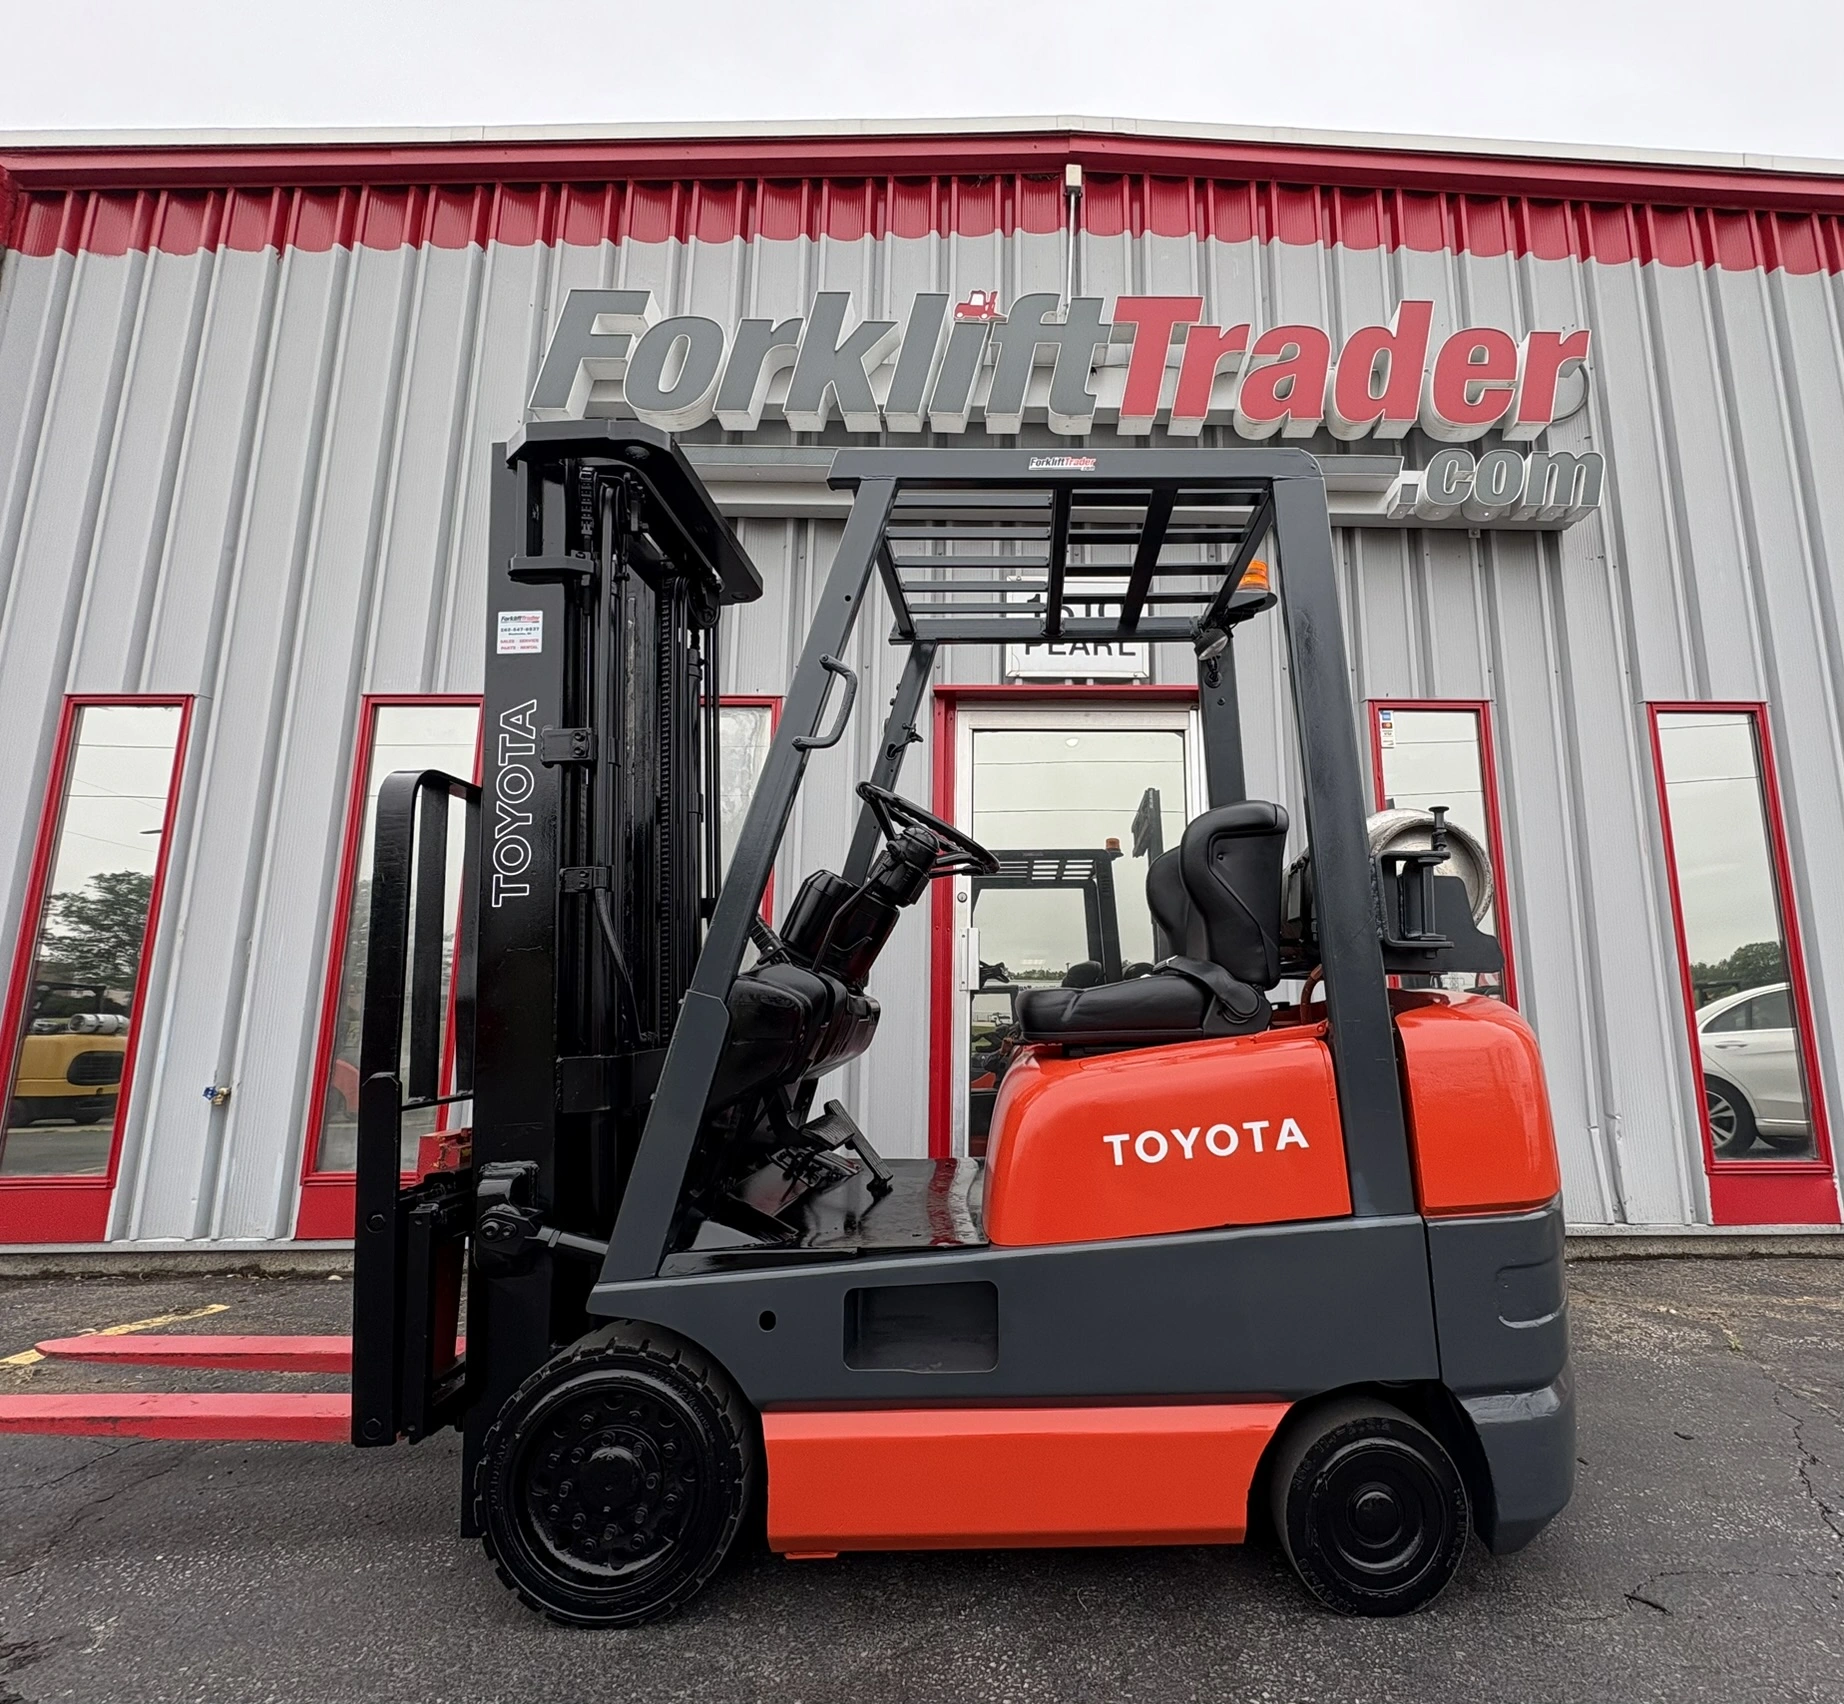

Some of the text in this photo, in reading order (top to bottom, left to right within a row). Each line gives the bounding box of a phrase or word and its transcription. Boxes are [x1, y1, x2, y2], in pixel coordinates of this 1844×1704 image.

[528, 288, 1593, 426] ForkliftTrader
[1030, 457, 1096, 467] ForkliftTrader
[1398, 447, 1607, 512] .com
[491, 698, 538, 908] TOYOTA
[1102, 1117, 1310, 1166] TOYOTA
